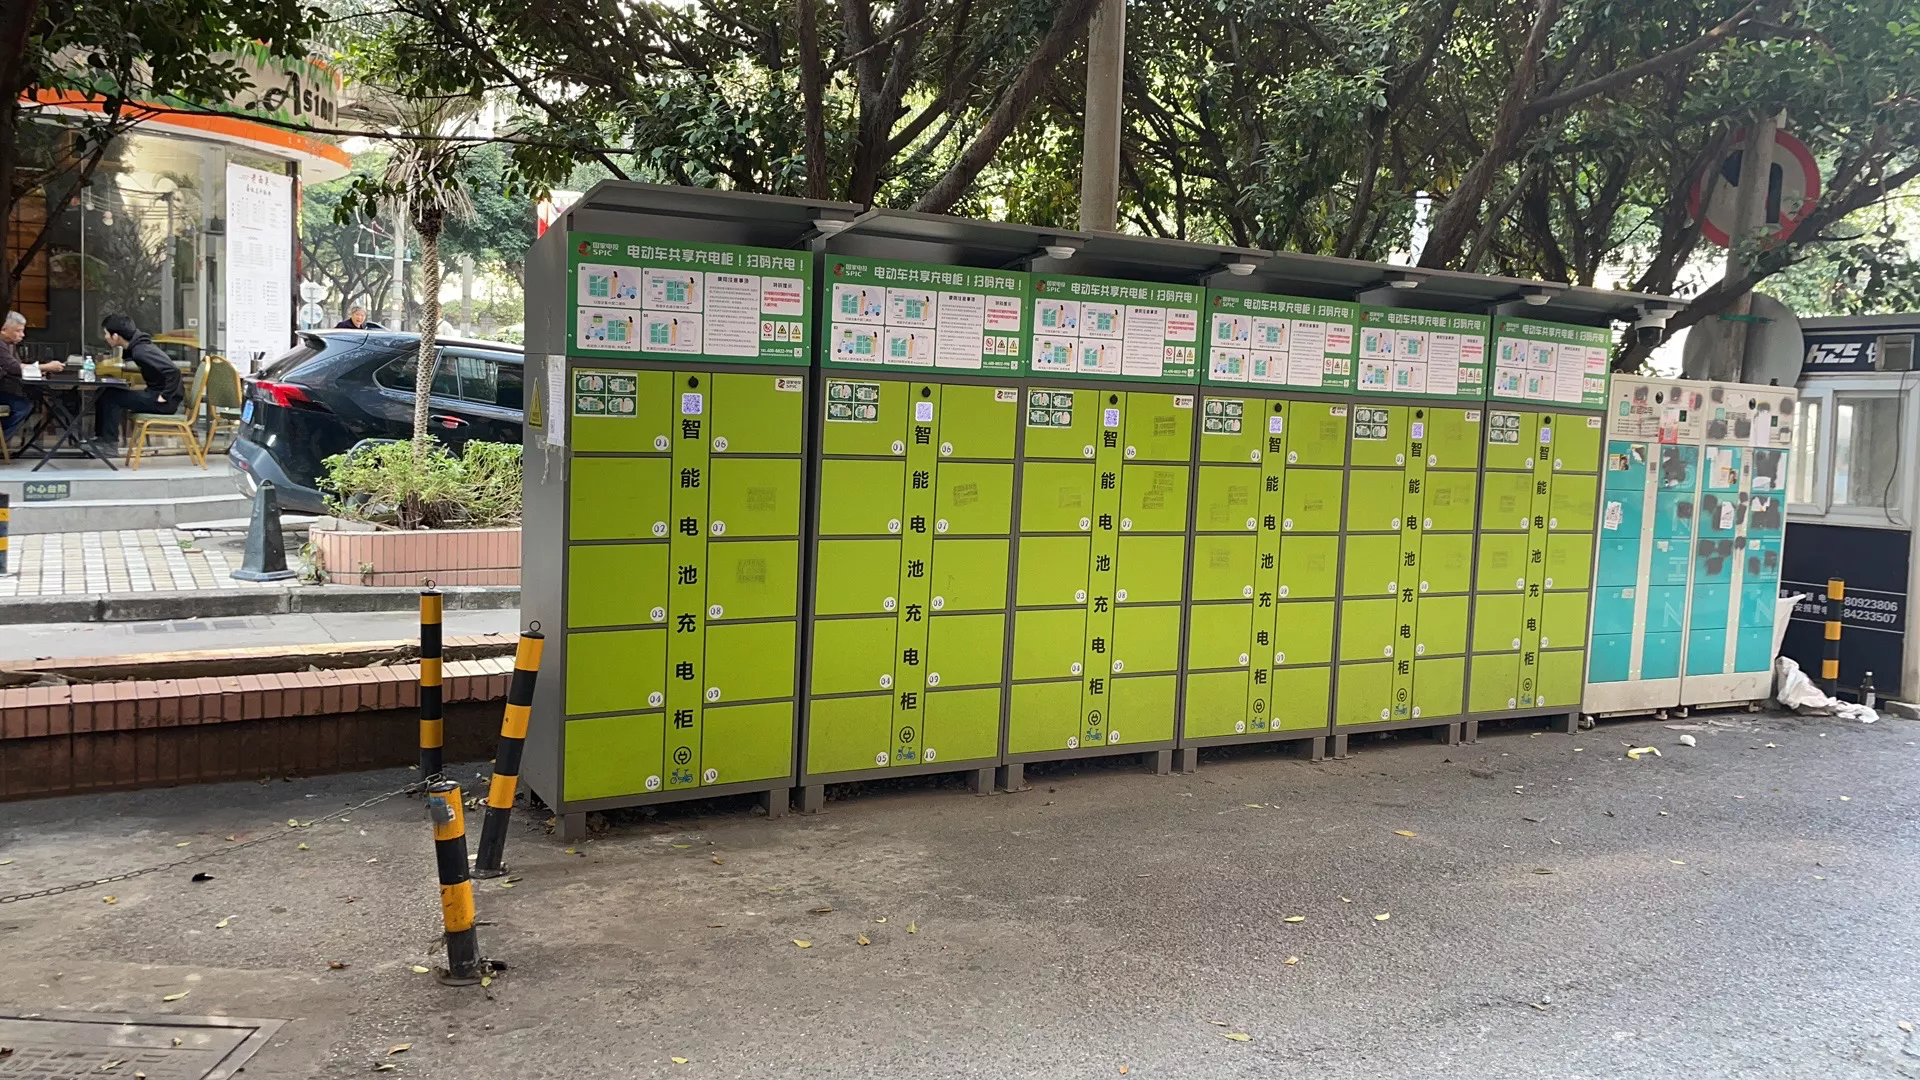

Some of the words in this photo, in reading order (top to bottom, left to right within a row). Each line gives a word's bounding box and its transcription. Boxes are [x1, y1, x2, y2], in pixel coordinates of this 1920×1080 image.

[592, 241, 619, 251] 国家电投
[592, 248, 613, 257] SPIC
[656, 438, 668, 448] 01
[714, 439, 727, 449] 06
[892, 443, 903, 452] 01
[941, 445, 952, 454] 06
[654, 524, 666, 533] 02
[712, 523, 724, 532] 07
[889, 521, 899, 530] 02
[937, 521, 947, 530] 07
[884, 599, 895, 608] 03
[933, 598, 943, 607] 08
[652, 609, 664, 619] 03
[710, 606, 722, 616] 08
[880, 677, 891, 686] 04
[929, 675, 939, 684] 09
[707, 689, 719, 699] 09
[649, 694, 661, 704] 04
[876, 754, 887, 763] 05
[925, 750, 935, 759] 10
[705, 770, 717, 781] 10
[646, 778, 659, 788] 05
